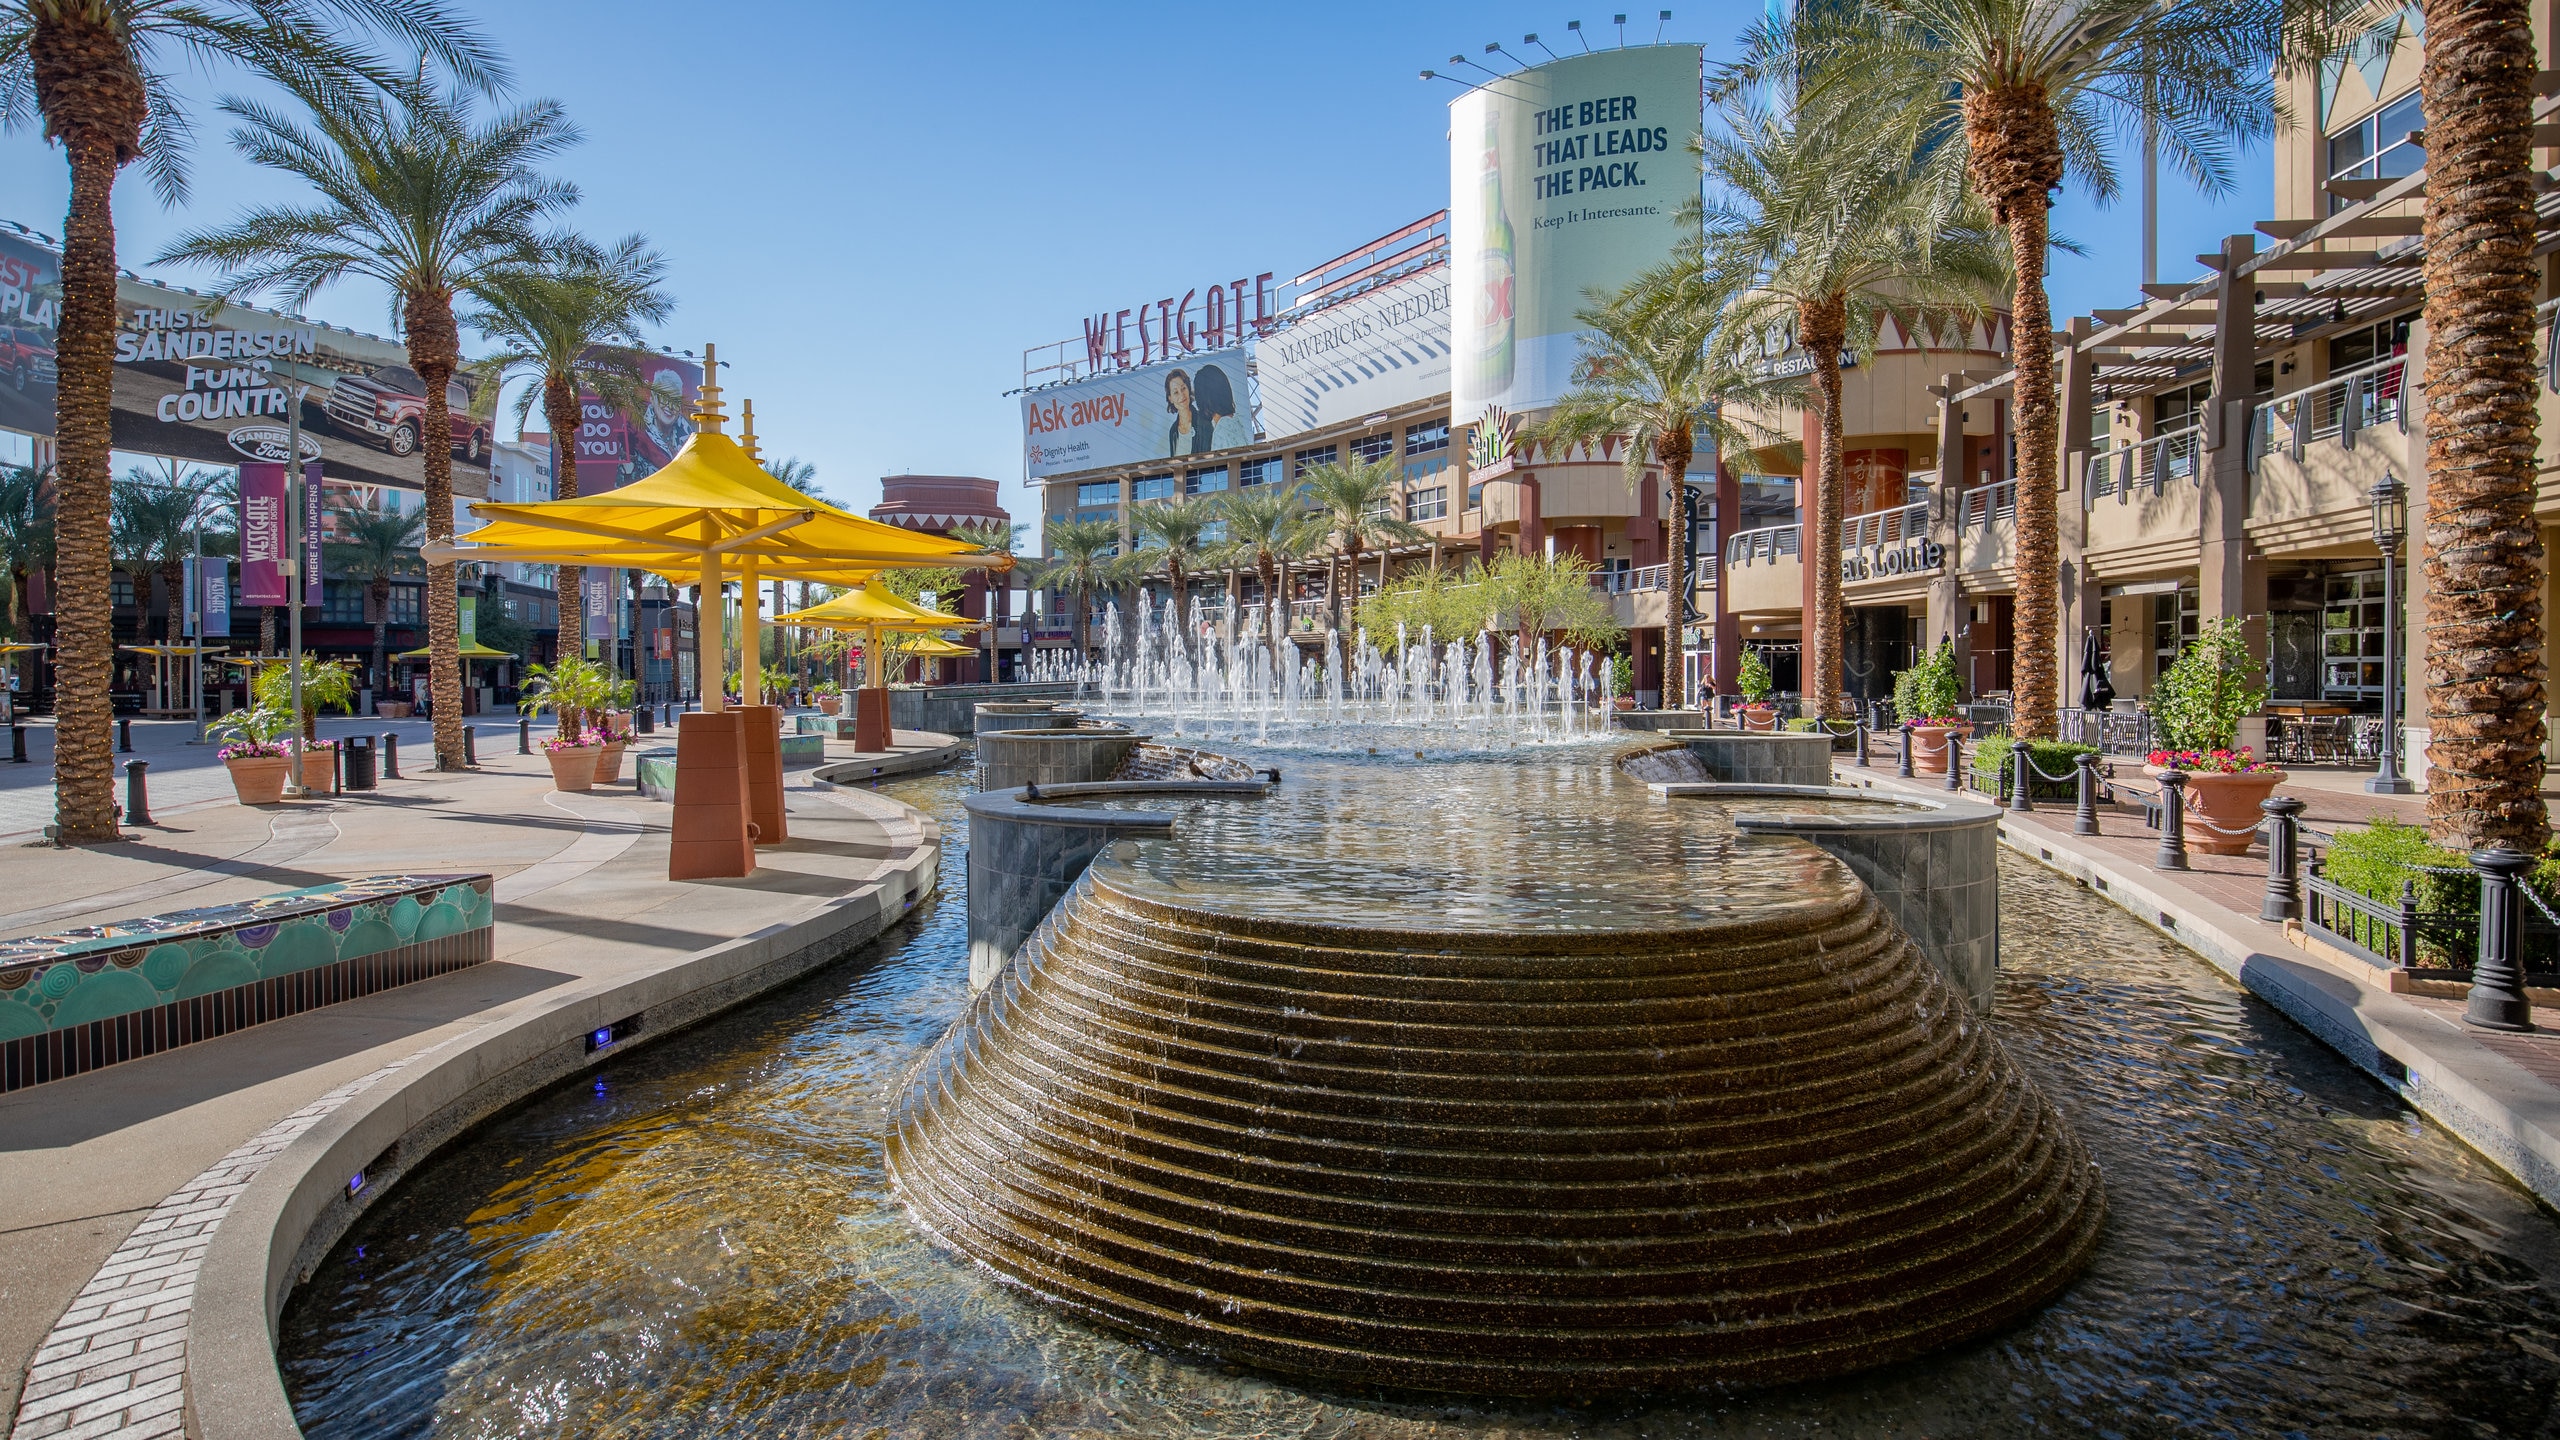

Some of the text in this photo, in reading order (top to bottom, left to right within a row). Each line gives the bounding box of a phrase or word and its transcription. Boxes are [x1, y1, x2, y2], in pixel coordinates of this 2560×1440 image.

[1534, 95, 1637, 136] THE BEER
[1534, 126, 1668, 168] THAT LEADS
[1534, 161, 1646, 201] THE PACK.
[1534, 205, 1660, 230] Keep It Interesante.
[134, 309, 213, 330] THIS IS
[1083, 271, 1273, 373] WESTGATE
[114, 328, 316, 363] SANDERSON
[1281, 314, 1372, 367] MAVERICKS
[185, 360, 273, 391] FORD
[598, 362, 606, 370] A
[156, 385, 310, 423] COUNTRY
[580, 404, 615, 419] YOU
[1028, 392, 1129, 435] Ask away.
[236, 431, 316, 455] SANDERON
[579, 441, 618, 455] YOU
[583, 423, 611, 437] DO
[1044, 440, 1089, 459] Dignity Health
[246, 495, 270, 563] WESTGATE
[310, 484, 319, 586] WHERE FUN HAPPENS
[1841, 537, 1945, 582] ar Louie
[211, 576, 226, 614] WESTGATE
[590, 581, 603, 617] WESTGATE
